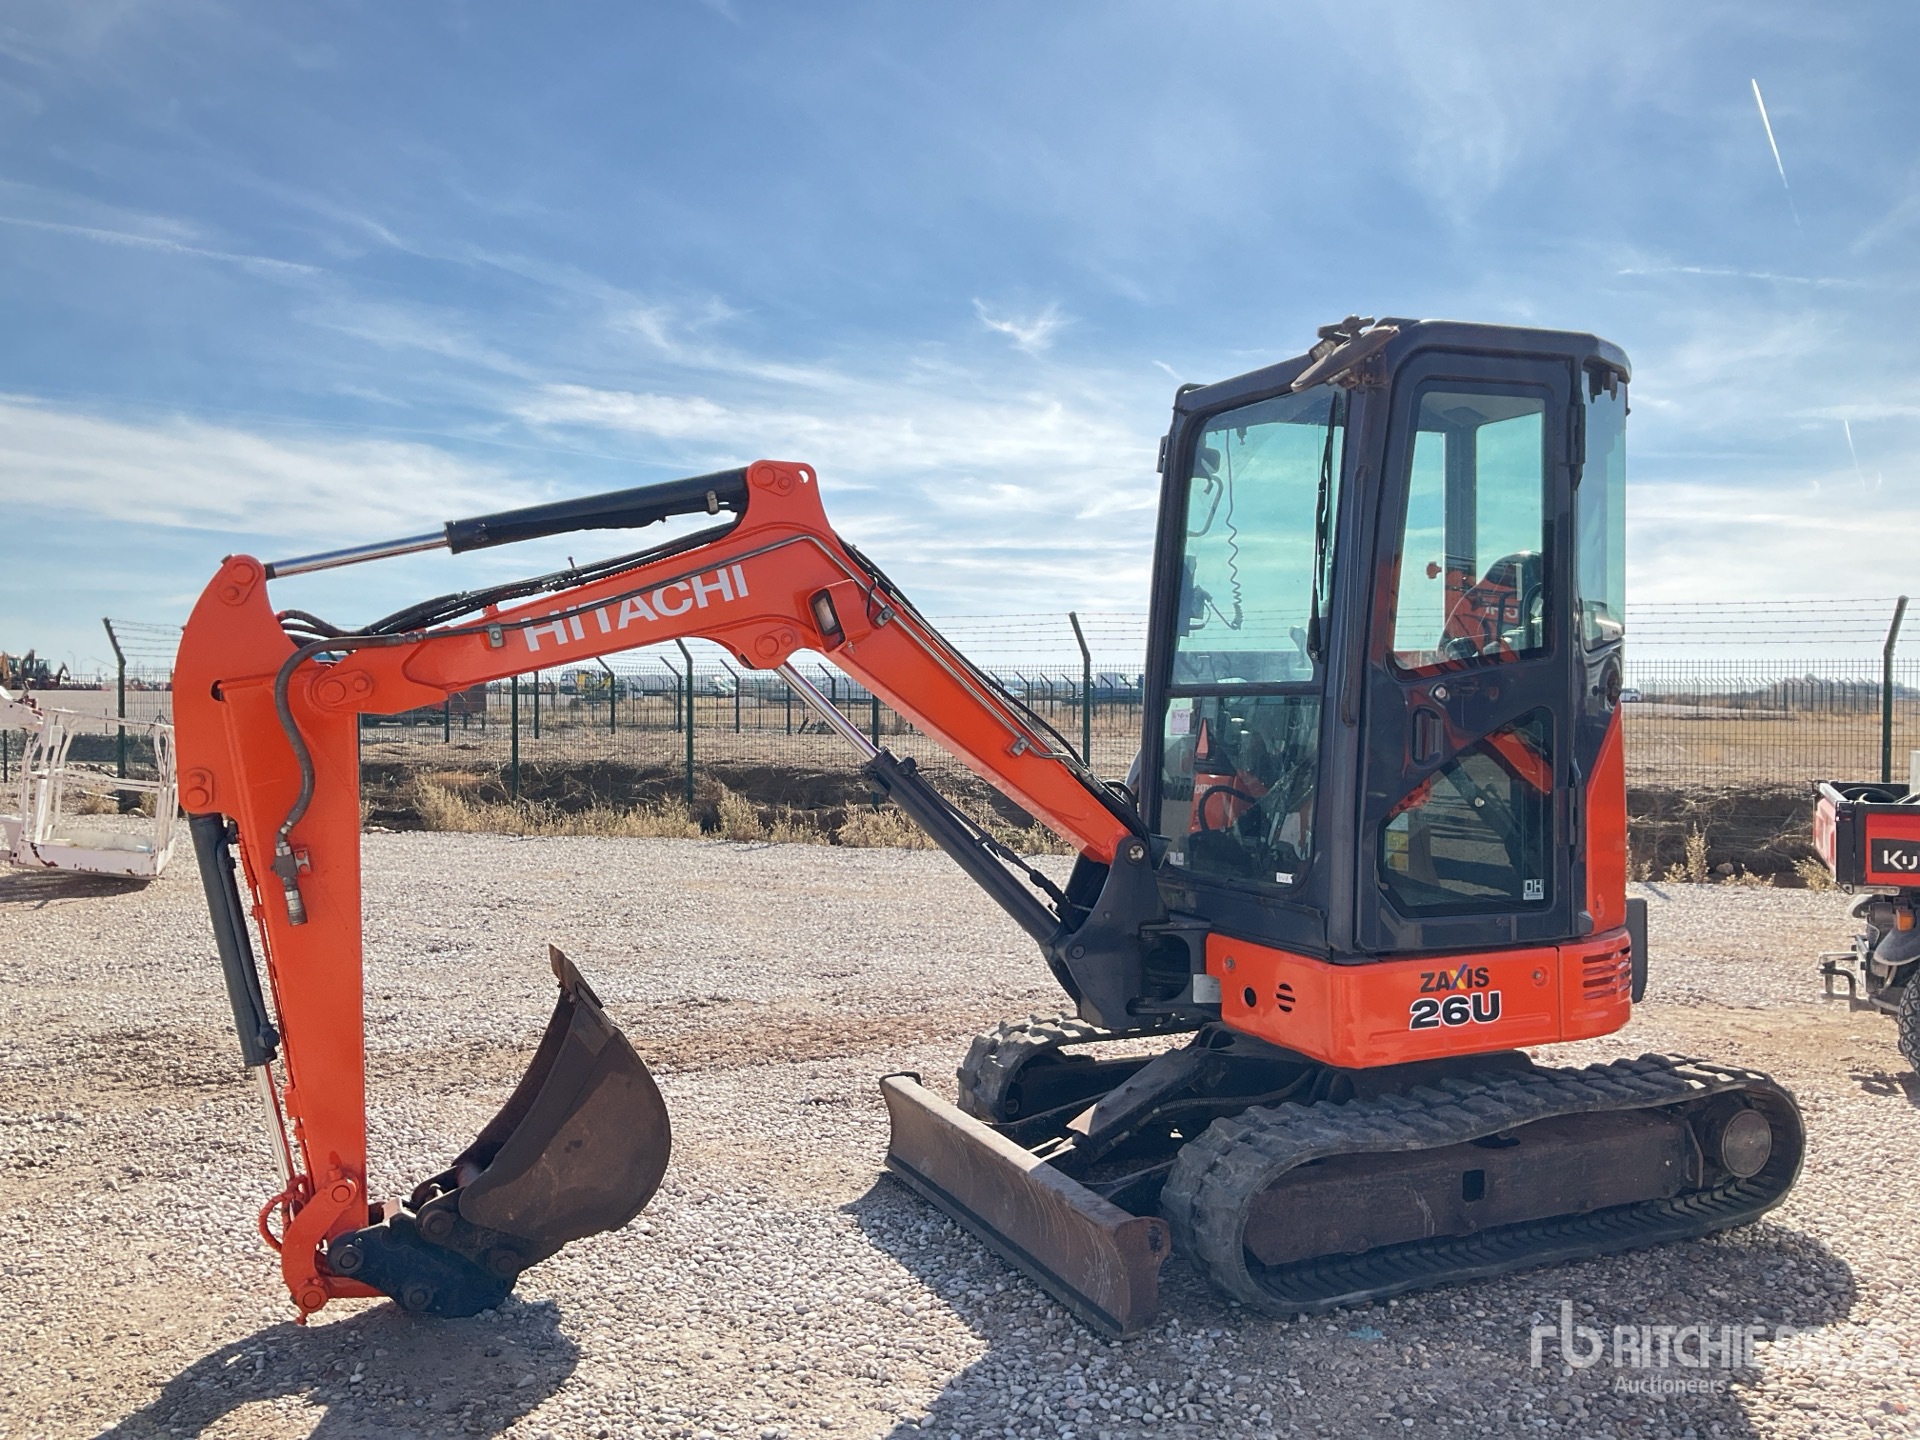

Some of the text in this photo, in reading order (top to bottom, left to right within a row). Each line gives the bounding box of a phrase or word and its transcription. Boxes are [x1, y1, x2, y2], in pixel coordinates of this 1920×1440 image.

[520, 564, 749, 652] HITACHI
[1420, 963, 1490, 993] ZAXIS
[1409, 990, 1502, 1031] 26U
